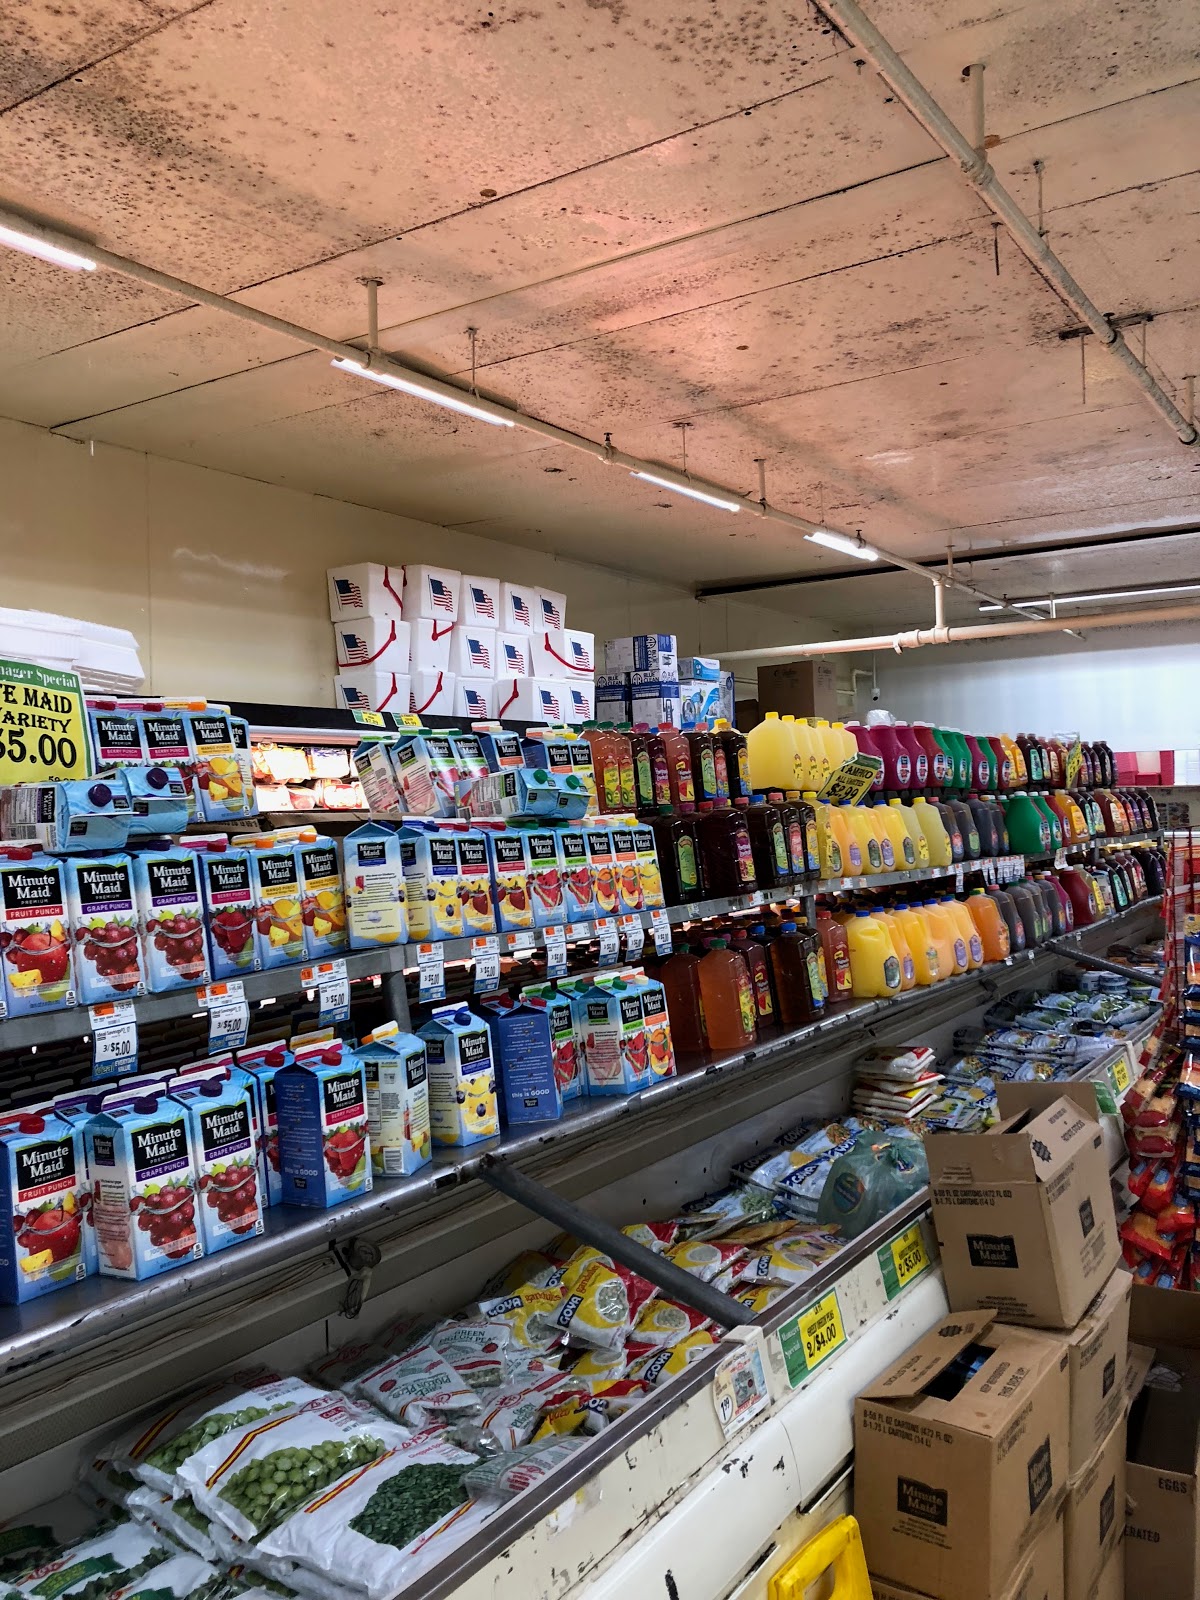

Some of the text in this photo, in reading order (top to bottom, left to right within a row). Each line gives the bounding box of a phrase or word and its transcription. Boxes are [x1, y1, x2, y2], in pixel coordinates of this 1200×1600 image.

[36, 668, 77, 688] Special
[23, 687, 73, 714] MAID
[0, 707, 72, 733] ARIETY
[194, 721, 225, 731] Minute
[102, 721, 135, 732] Minute
[148, 722, 181, 733] Minute
[108, 731, 133, 741] Maid
[155, 732, 179, 741] Maid
[201, 729, 223, 739] Maid
[531, 838, 553, 847] Minute
[565, 837, 583, 845] Minute
[590, 835, 608, 844] Minute
[614, 834, 632, 842] Minute
[359, 844, 383, 852] Minute
[433, 842, 454, 851] Minute
[461, 842, 484, 851] Minute
[498, 841, 520, 849] Minute
[536, 845, 551, 854] Maid
[569, 844, 582, 852] Maid
[595, 842, 608, 850] Maid
[618, 841, 631, 849] Maid
[305, 853, 333, 865] Minute
[437, 851, 452, 859] Maid
[466, 851, 482, 859] Maid
[502, 849, 519, 857] Maid
[153, 865, 191, 877] Minute
[213, 863, 245, 875] Minute
[262, 859, 293, 871] Minute
[311, 861, 331, 873] Maid
[83, 871, 125, 883] Minute
[219, 873, 243, 885] Maid
[268, 868, 290, 880] Maid
[8, 875, 55, 887] Minute
[160, 876, 188, 888] Maid
[17, 886, 51, 899] Maid
[91, 882, 122, 894] Maid
[156, 895, 196, 905] GRAPE PUNCH
[10, 907, 60, 918] FRUIT PUNCH
[87, 902, 129, 912] GRAPE PUNCH
[622, 1000, 640, 1011] Minute
[643, 994, 662, 1005] Minute
[647, 1001, 661, 1011] Maid
[625, 1008, 639, 1018] Maid
[217, 1018, 241, 1032] 3/$5.00
[103, 1040, 131, 1056] 3/$5.00
[461, 1036, 486, 1049] Minute
[465, 1044, 483, 1057] Maid
[327, 1078, 359, 1094] Minute
[333, 1089, 356, 1104] Maid
[206, 1110, 244, 1129] Minute
[212, 1123, 240, 1139] Maid
[137, 1128, 181, 1148] Minute
[22, 1145, 69, 1167] Minute
[145, 1141, 177, 1159] Maid
[209, 1141, 248, 1159] GRAPE PUNCH
[30, 1162, 64, 1178] Maid
[141, 1160, 185, 1179] GRAPE PUNCH
[300, 1168, 318, 1176] GOOD
[35, 1172, 61, 1183] PREMIUM
[23, 1179, 73, 1199] FRUIT PUNCH
[972, 1240, 1010, 1251] Minute
[980, 1250, 1007, 1261] Maid
[758, 1256, 771, 1276] GOYA
[898, 1250, 921, 1277] 2/$5.00
[547, 1268, 566, 1286] OYA
[488, 1297, 521, 1315] GOYA
[559, 1295, 582, 1325] GOYA
[806, 1323, 837, 1358] 2/$4.00
[647, 1352, 671, 1380] GOYA
[1158, 1477, 1187, 1494] EGGS
[903, 1483, 943, 1506] Minute
[909, 1496, 938, 1515] Maid
